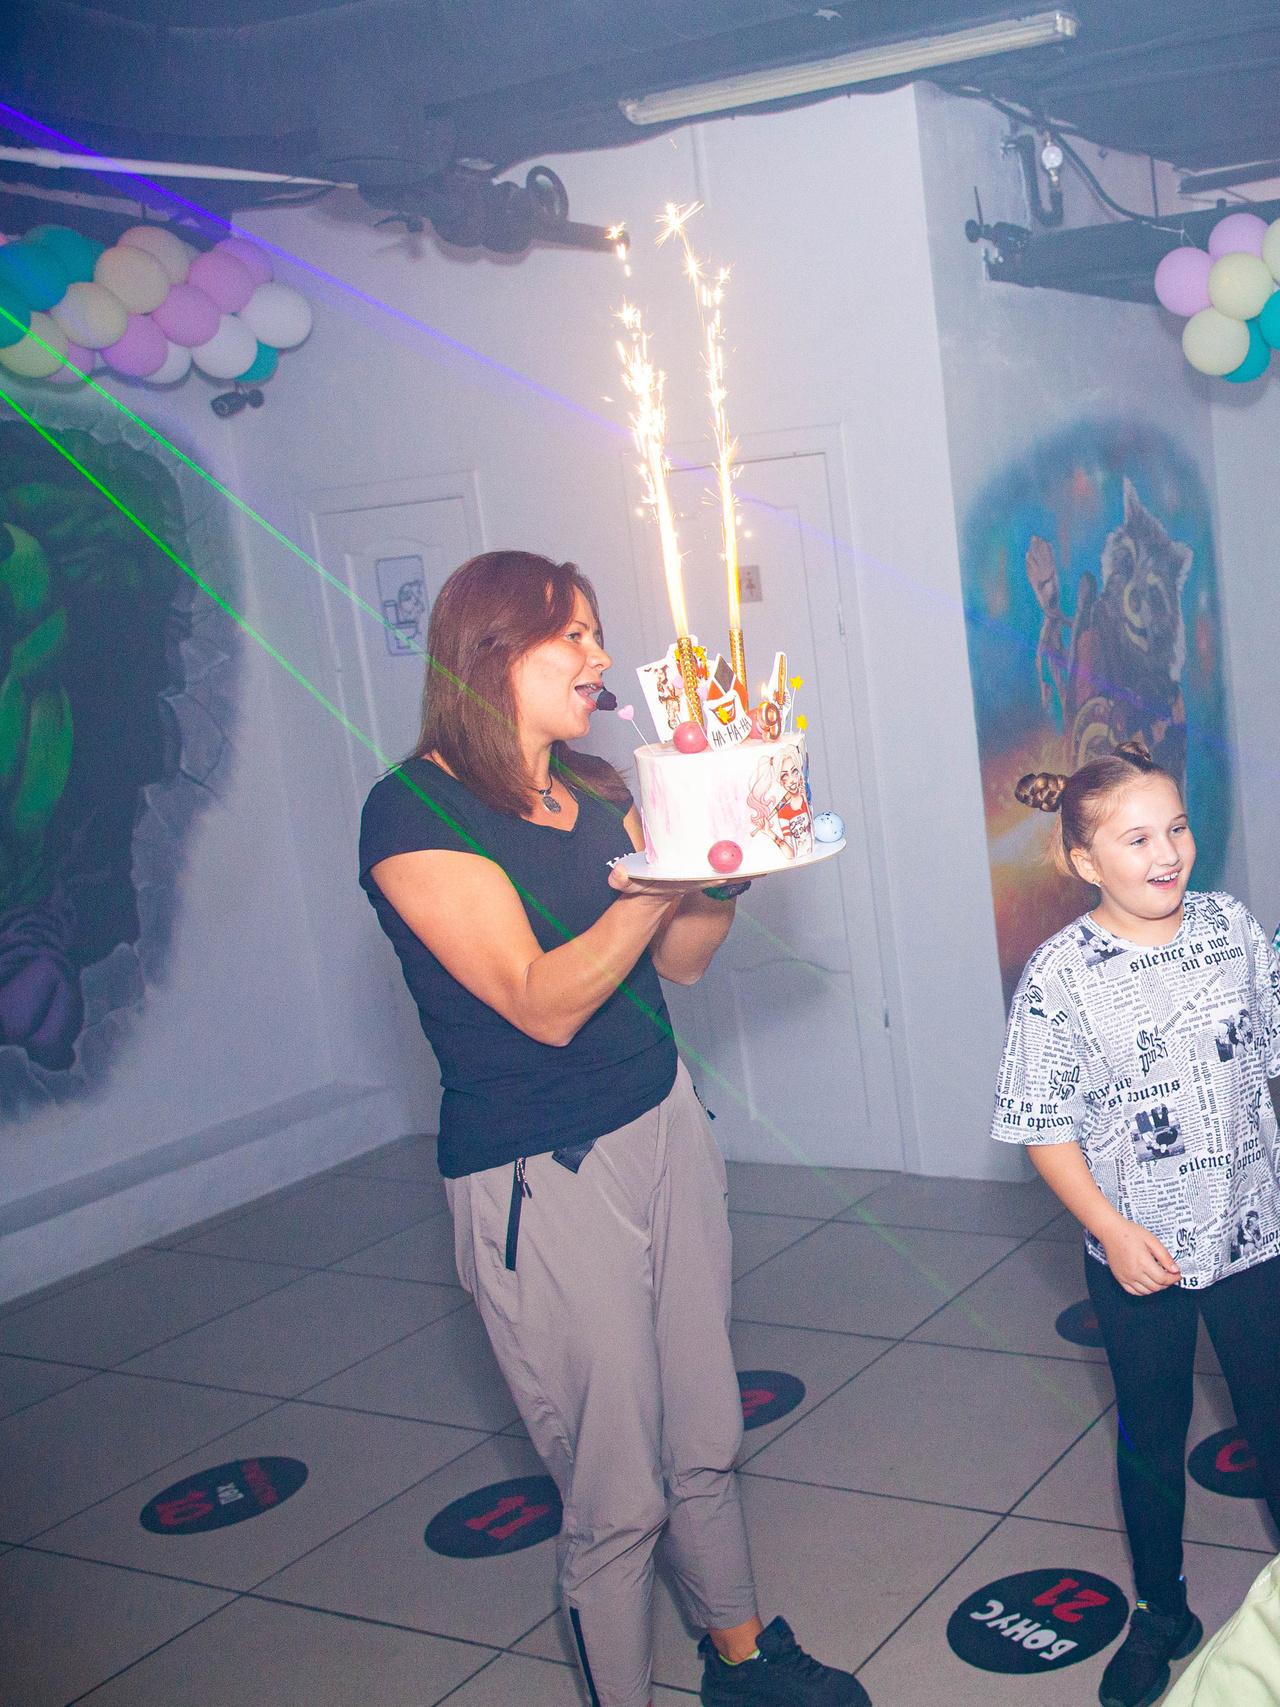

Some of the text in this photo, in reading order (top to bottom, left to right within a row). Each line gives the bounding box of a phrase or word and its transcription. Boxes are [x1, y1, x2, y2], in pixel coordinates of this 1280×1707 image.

[757, 701, 782, 743] 9
[1129, 934, 1230, 973] silence is not
[1181, 958, 1201, 973] an
[1204, 945, 1244, 967] option
[1207, 967, 1226, 988] Women
[1080, 1010, 1094, 1036] wanna
[1114, 1077, 1132, 1092] an
[1192, 1064, 1200, 1084] have
[1200, 1061, 1212, 1086] rights
[1127, 1078, 1180, 1103] silence
[1198, 1085, 1207, 1111] wanna
[1207, 1089, 1218, 1115] human
[1020, 1097, 1033, 1113] is
[1039, 1103, 1058, 1115] not
[1003, 1112, 1074, 1131] an option
[1203, 1113, 1211, 1129] just
[1206, 1132, 1216, 1154] Girls
[1178, 1153, 1231, 1177] silence
[1243, 1137, 1258, 1153] not
[1237, 1147, 1266, 1170] option
[1032, 1577, 1110, 1623] 21
[970, 1599, 1078, 1661] БОНУС
